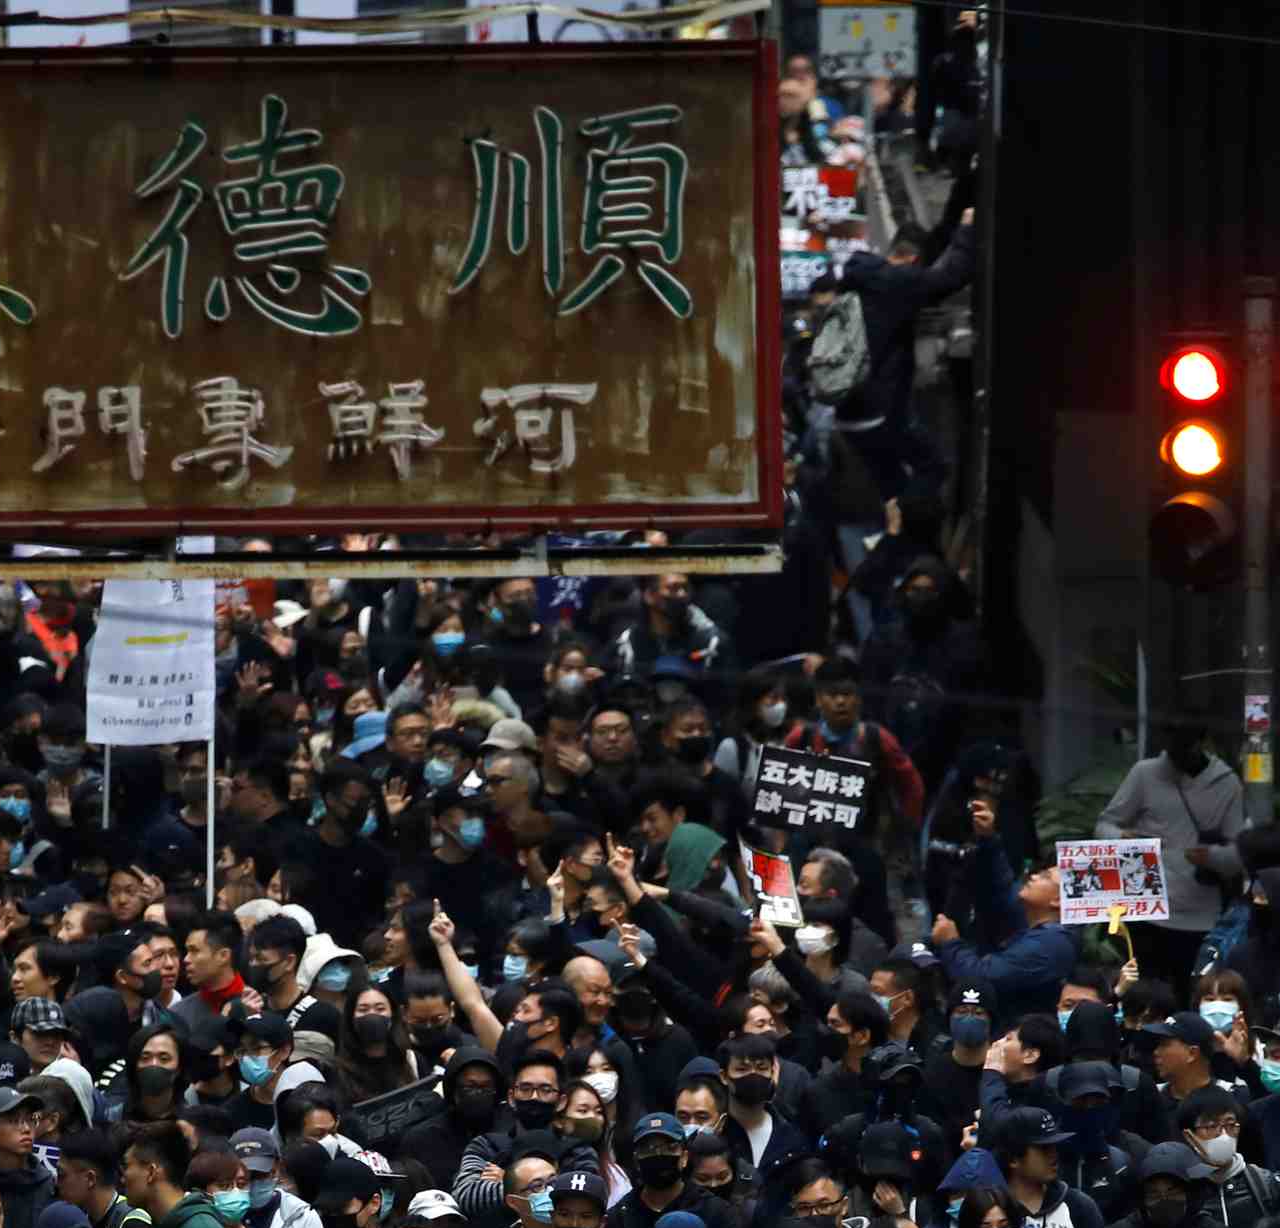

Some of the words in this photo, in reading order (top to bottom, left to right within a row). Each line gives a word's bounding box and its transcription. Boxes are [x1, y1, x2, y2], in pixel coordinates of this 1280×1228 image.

[761, 757, 867, 798] 五大訴求
[1060, 846, 1118, 858] 五大訴求
